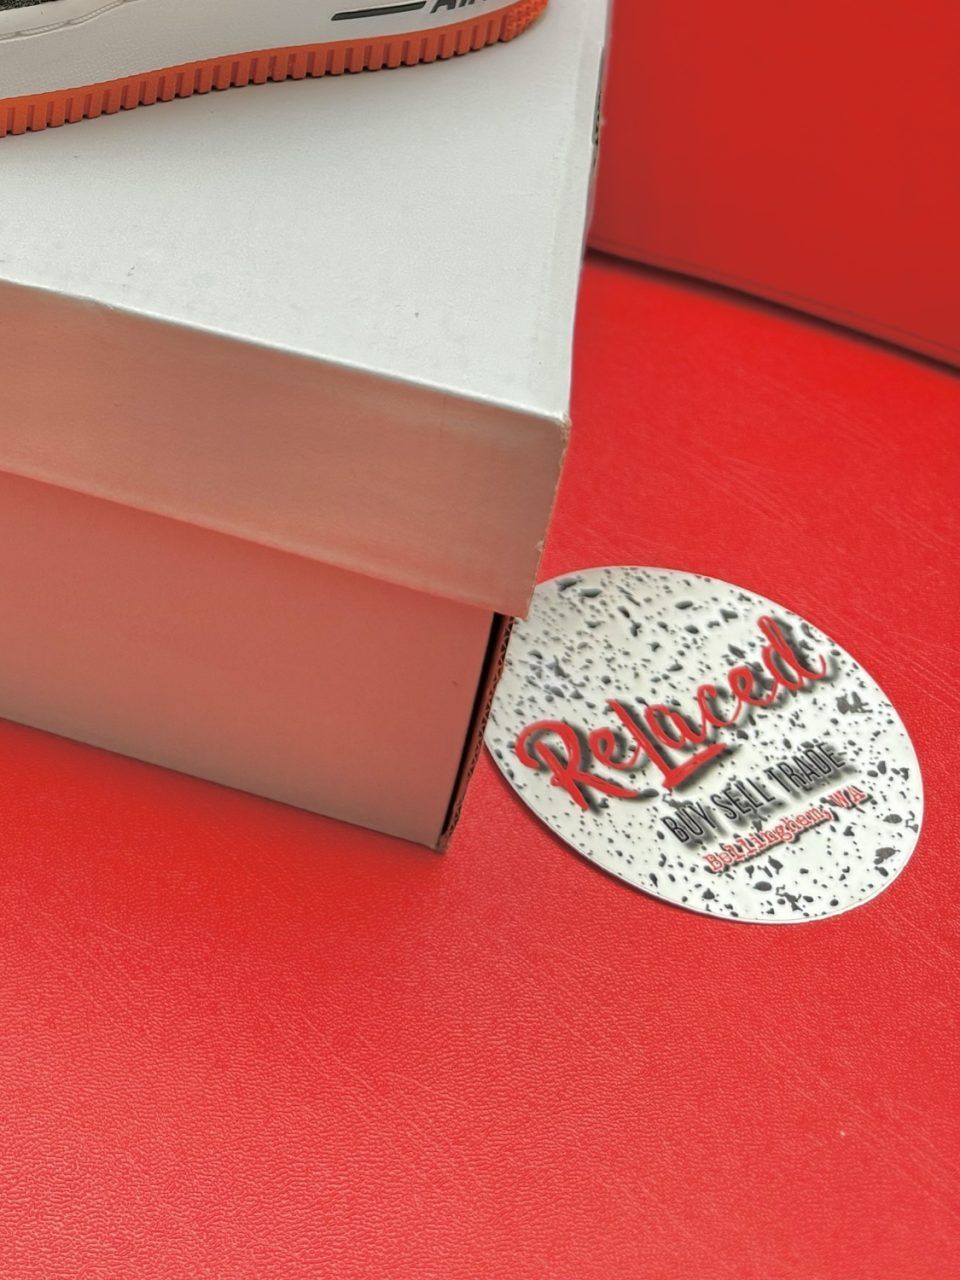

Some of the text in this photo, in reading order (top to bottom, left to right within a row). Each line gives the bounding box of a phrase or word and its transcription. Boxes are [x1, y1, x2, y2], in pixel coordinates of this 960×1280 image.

[661, 741, 846, 844] BUY SELL TRADE
[703, 785, 868, 872] Bellingham, WA
